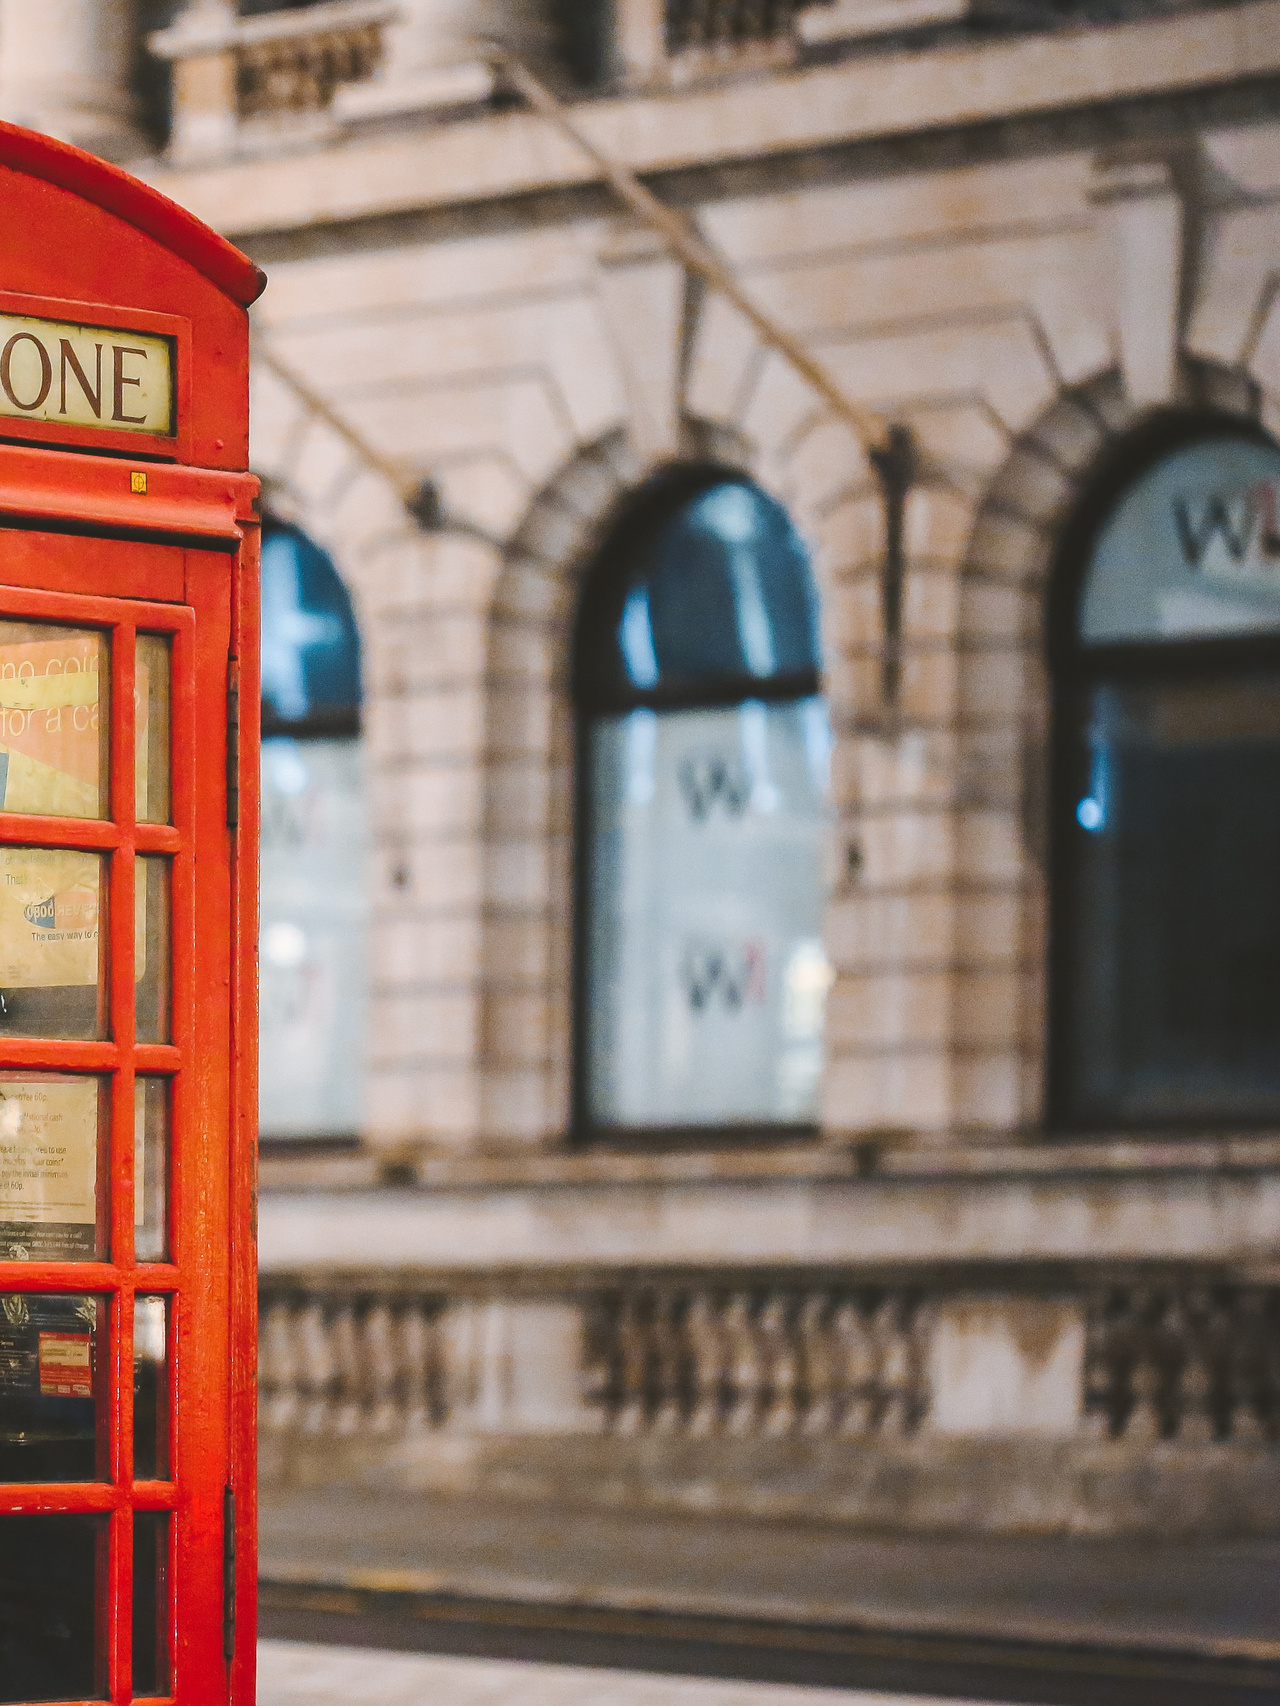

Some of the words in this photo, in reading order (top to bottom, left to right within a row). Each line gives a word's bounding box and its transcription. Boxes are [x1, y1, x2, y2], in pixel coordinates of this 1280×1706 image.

[0, 707, 36, 737] for
[45, 707, 62, 734] a
[31, 932, 45, 942] The
[47, 932, 65, 942] easy
[66, 931, 83, 941] way
